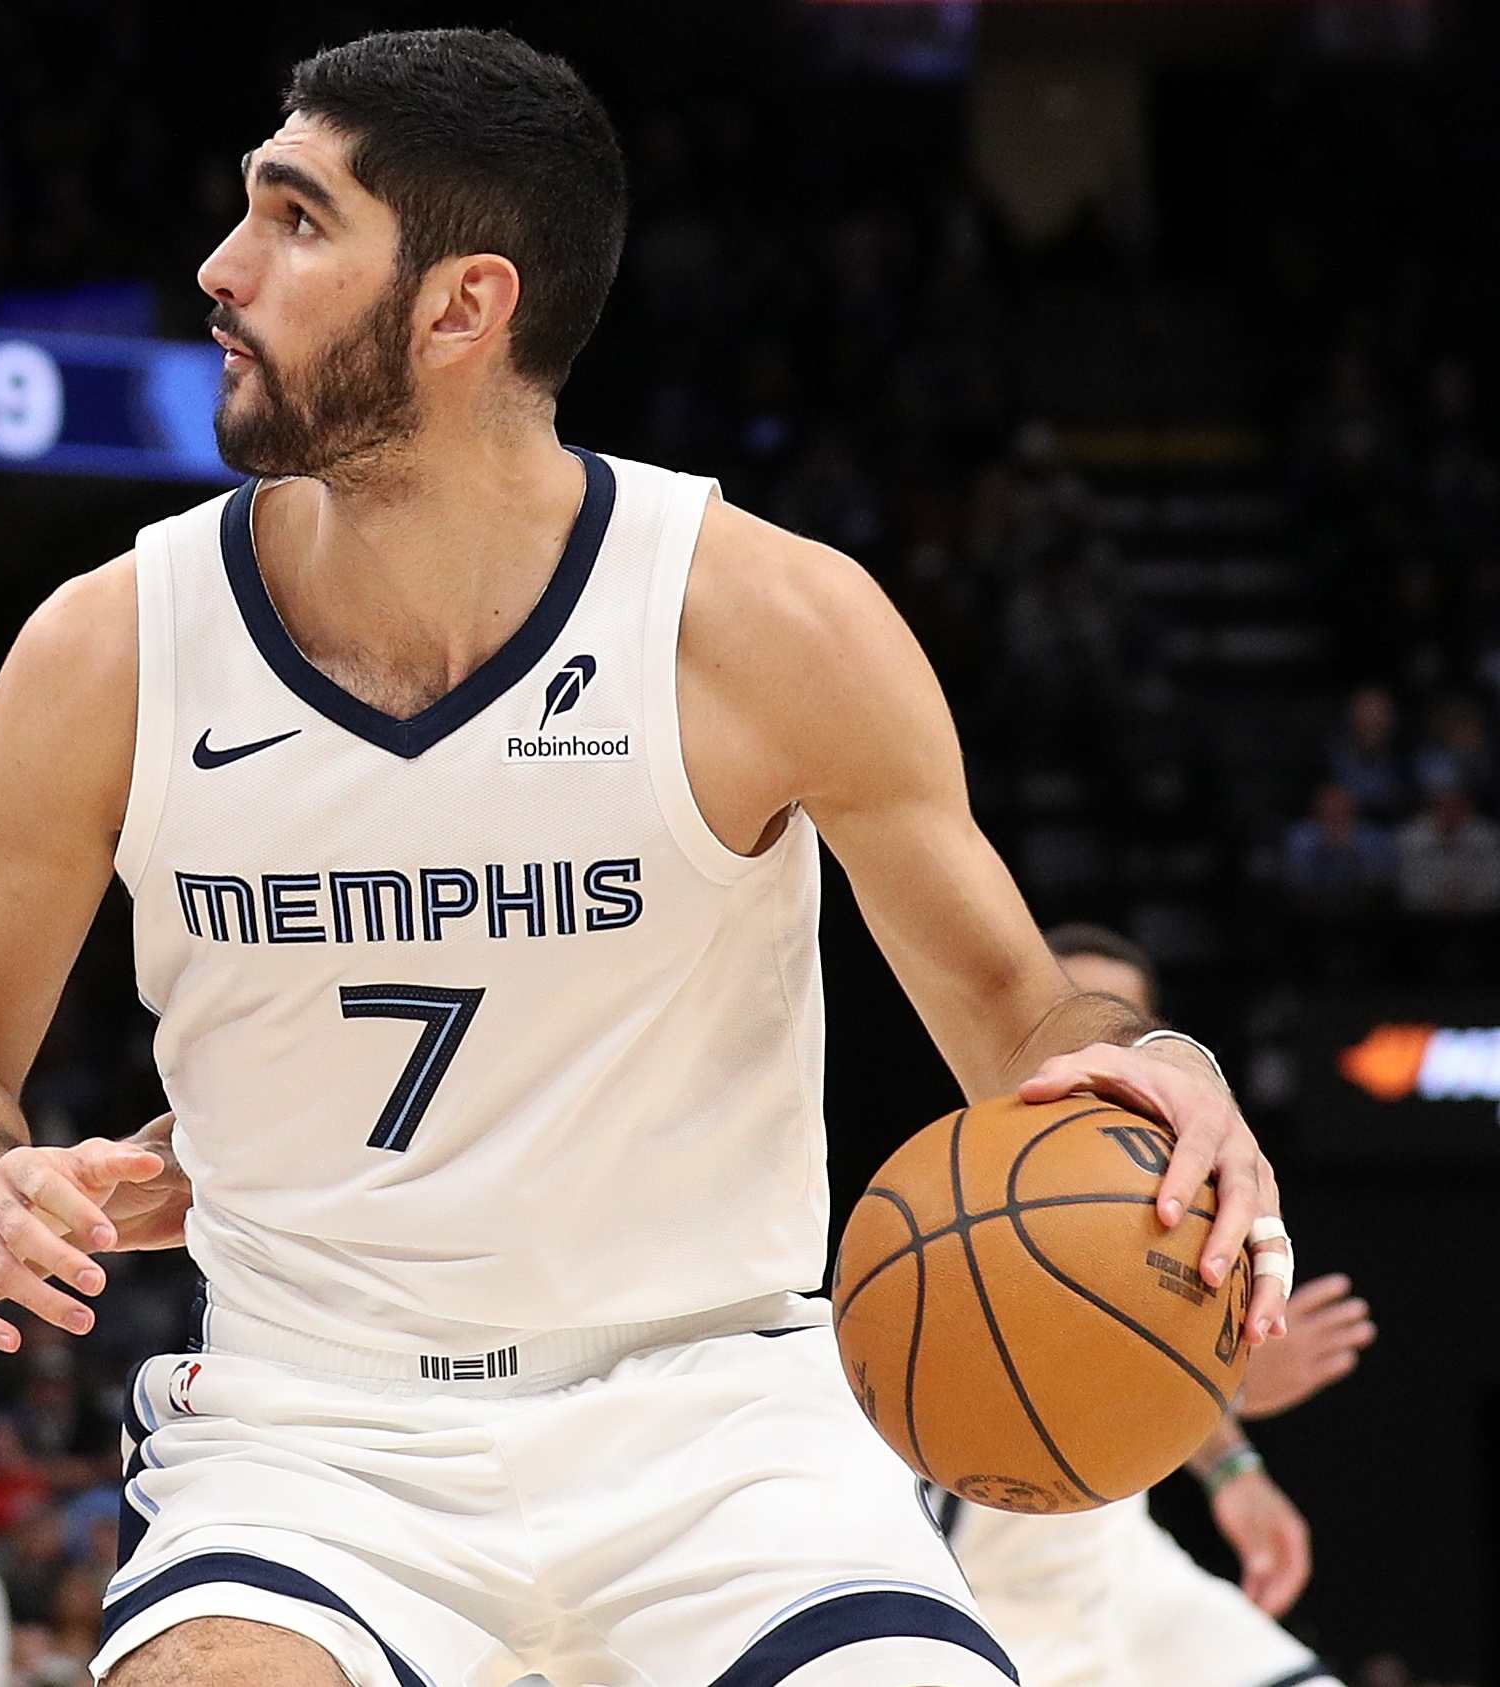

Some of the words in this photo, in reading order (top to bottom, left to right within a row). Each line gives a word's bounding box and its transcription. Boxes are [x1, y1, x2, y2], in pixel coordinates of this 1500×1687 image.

[508, 735, 629, 758] Robinhood
[175, 857, 644, 944] MEMPHIS
[339, 983, 487, 1153] 7
